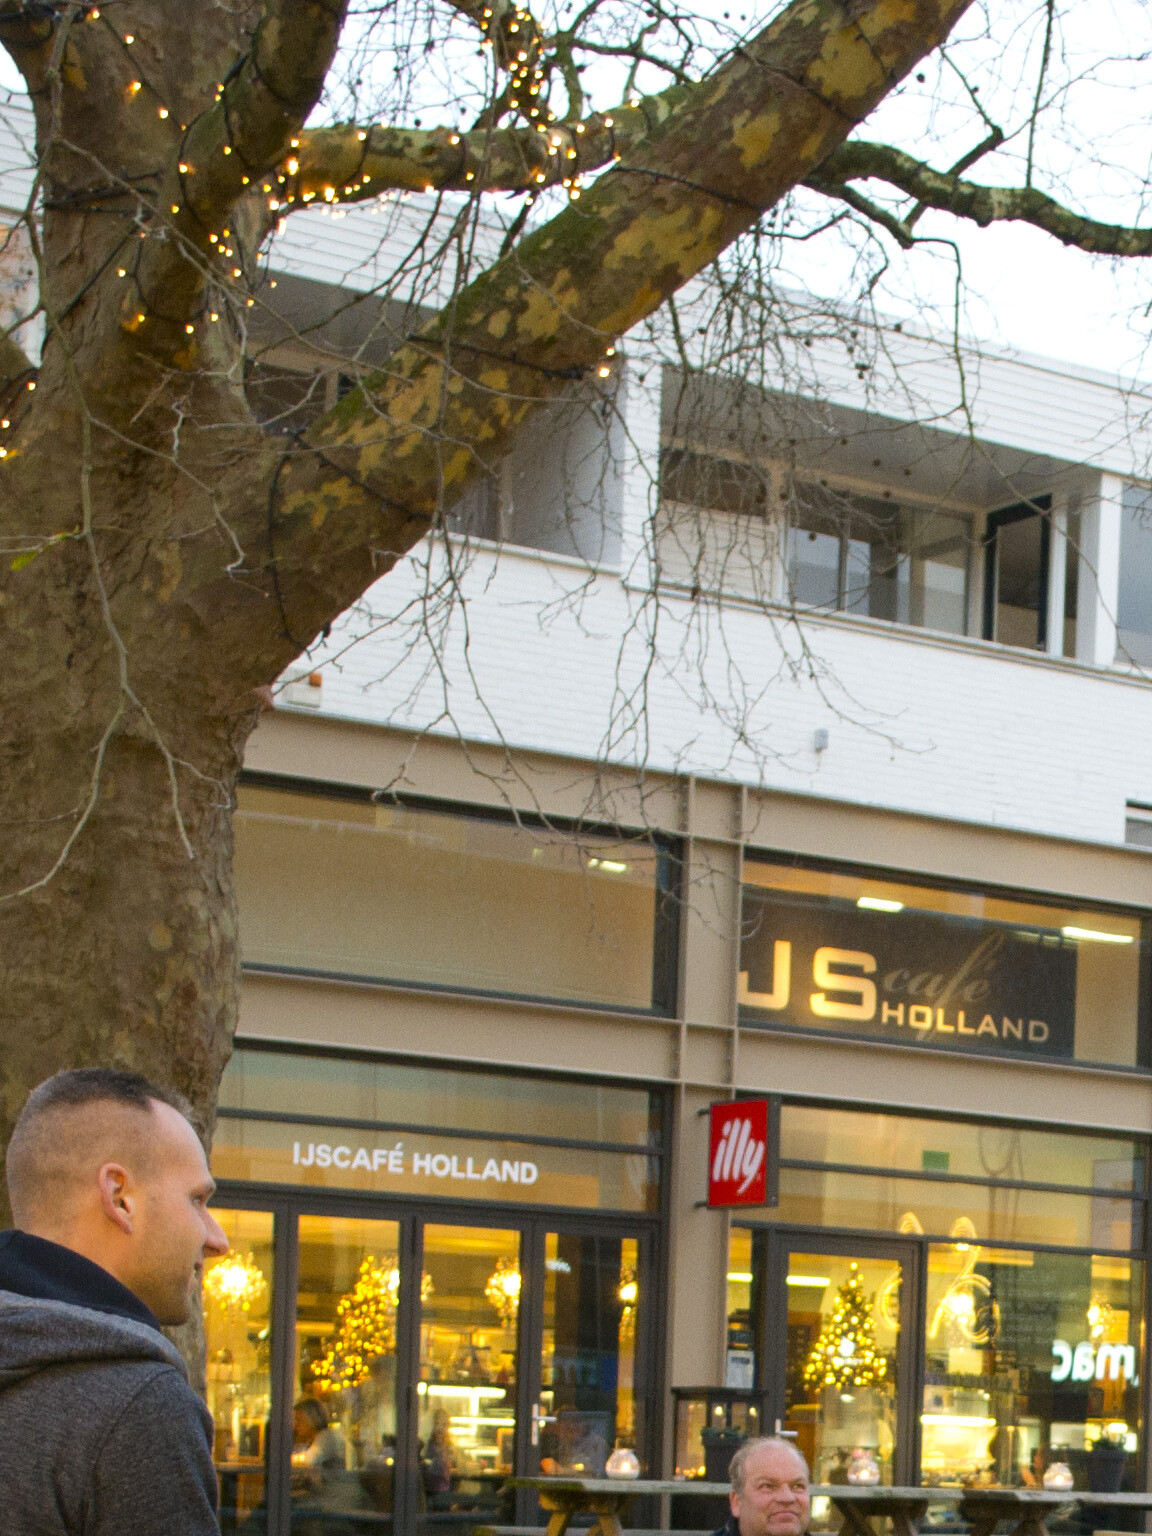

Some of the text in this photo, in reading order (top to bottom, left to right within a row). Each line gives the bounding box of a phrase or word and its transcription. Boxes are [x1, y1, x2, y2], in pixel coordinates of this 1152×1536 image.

[881, 1000, 1050, 1043] HOLLAND
[293, 1142, 538, 1184] IJSCAFÉ HOLLAND
[713, 1118, 765, 1194] illy
